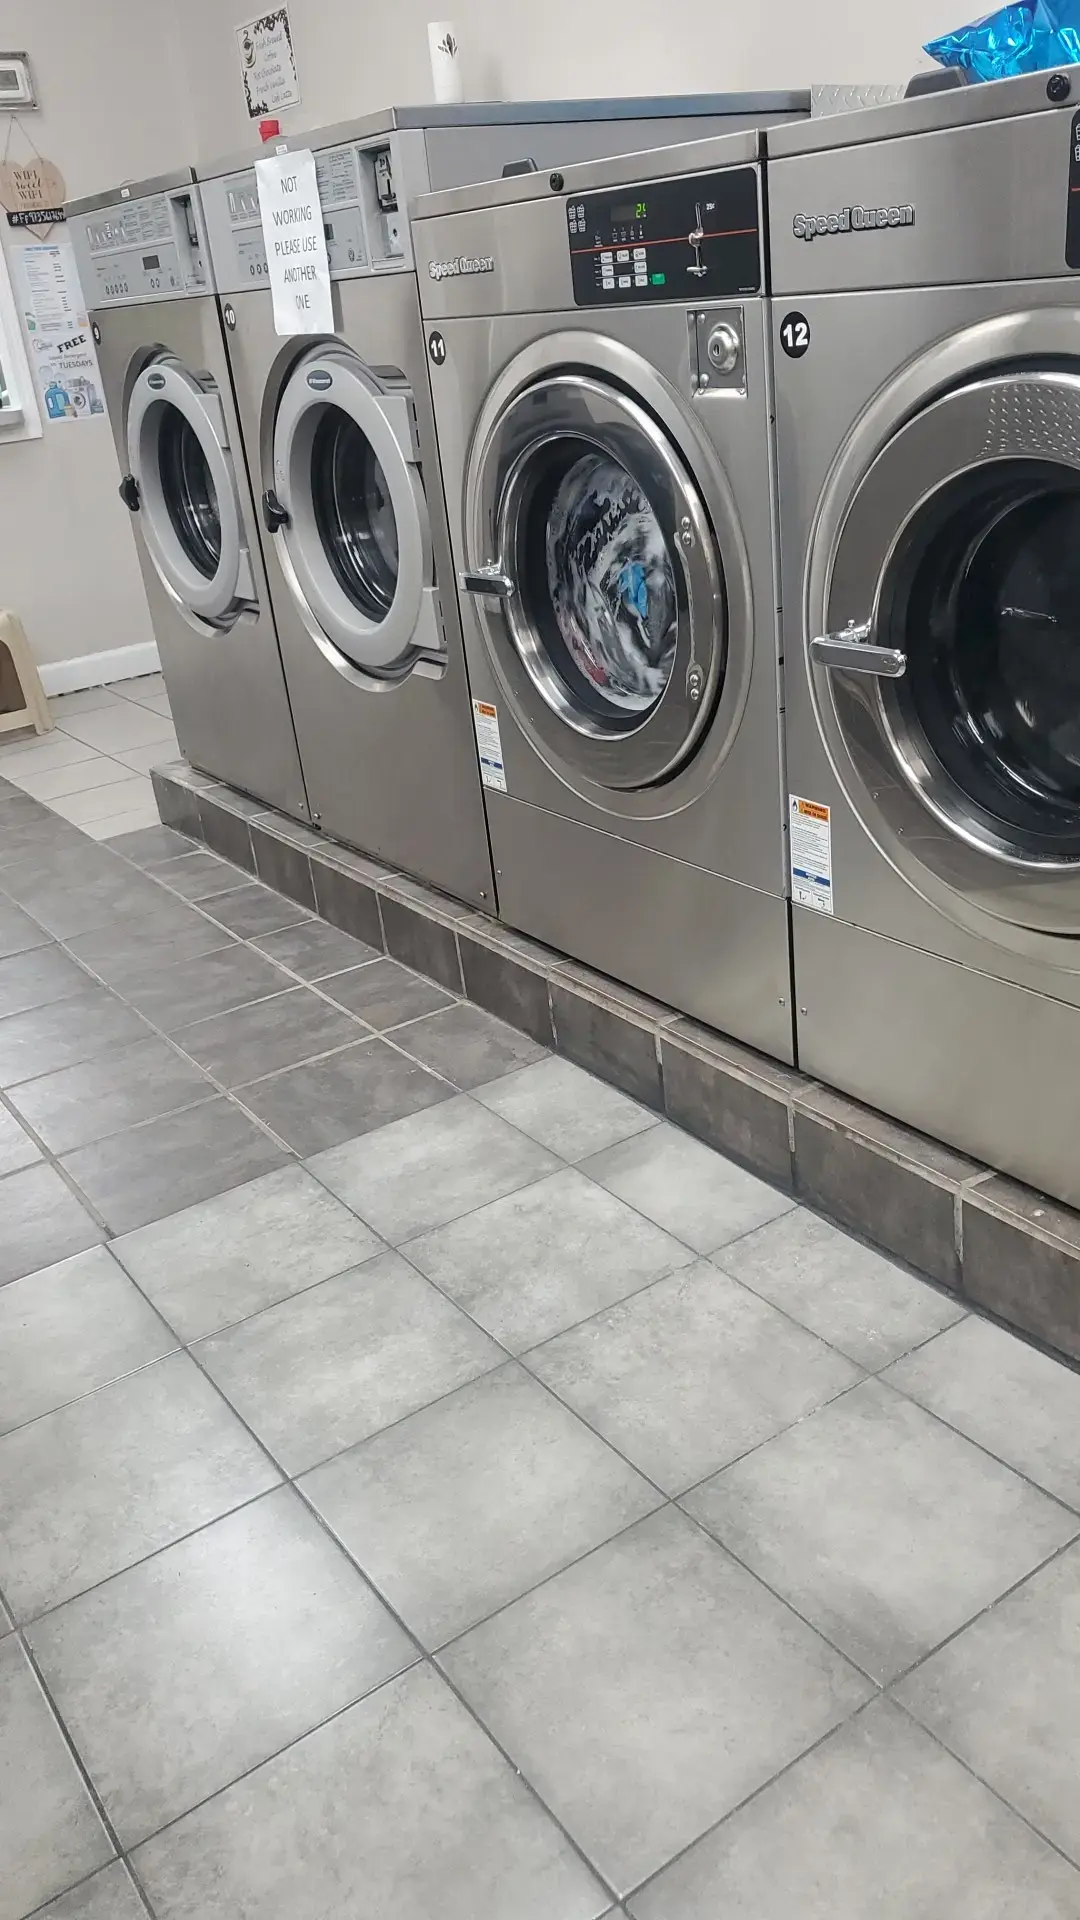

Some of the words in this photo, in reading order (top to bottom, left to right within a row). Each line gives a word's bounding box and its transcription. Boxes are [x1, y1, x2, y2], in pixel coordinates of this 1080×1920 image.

[13, 169, 38, 181] WIFI
[15, 178, 42, 190] sweet
[280, 176, 298, 194] NOT
[18, 189, 43, 200] WIFI
[272, 205, 313, 226] WORKING
[793, 207, 852, 241] Speed
[851, 204, 915, 232] Queen
[274, 238, 301, 256] PLEASE
[302, 236, 318, 251] USE
[283, 265, 317, 283] ANOTHER
[429, 258, 460, 281] Speed
[459, 256, 494, 274] Queen
[295, 294, 311, 310] ONE
[225, 310, 236, 325] 10
[783, 322, 808, 347] 12
[57, 334, 87, 354] FREE
[431, 339, 445, 358] 11
[59, 360, 93, 369] TUESDAYS
